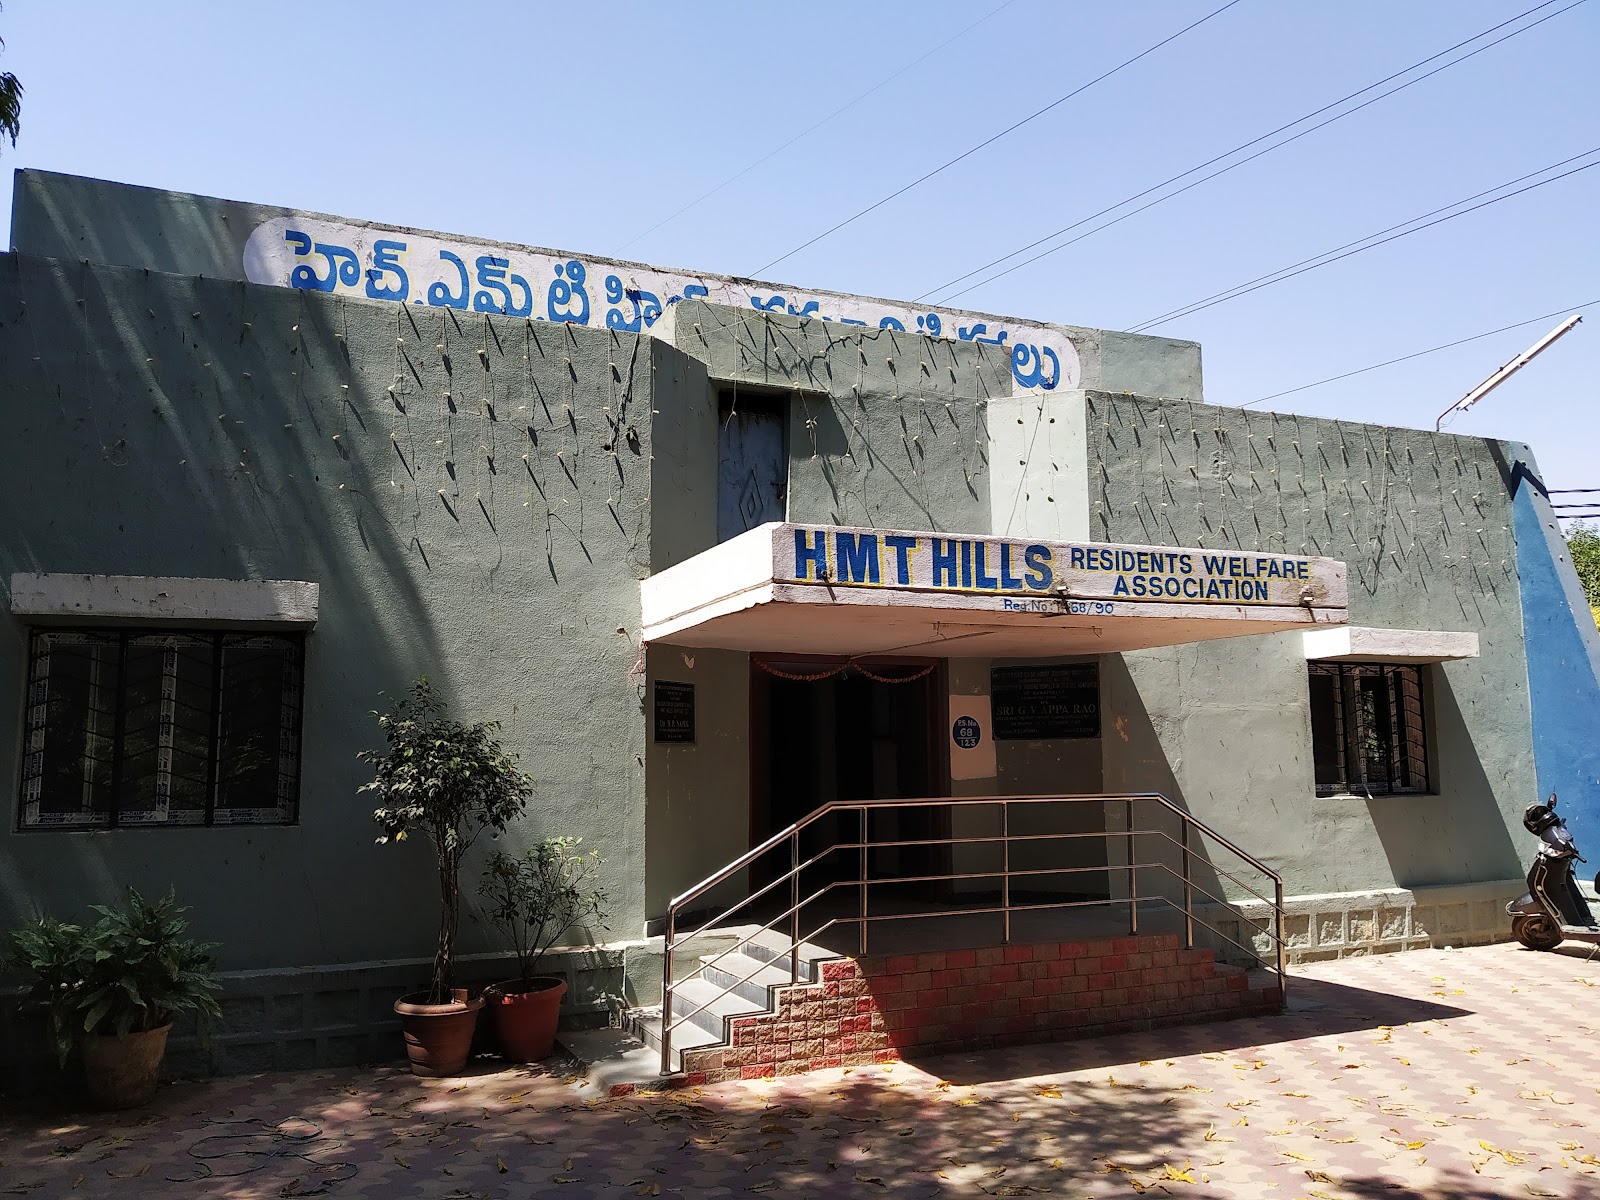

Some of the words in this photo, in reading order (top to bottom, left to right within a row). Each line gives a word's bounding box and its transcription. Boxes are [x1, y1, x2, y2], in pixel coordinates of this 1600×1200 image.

[794, 529, 918, 586] HMT
[931, 537, 1053, 591] HILLS
[1071, 547, 1192, 575] RESIDENTS
[1202, 555, 1309, 580] WELFARE
[1113, 574, 1268, 601] ASSOCIATION
[996, 706, 1014, 716] SRI
[1018, 705, 1026, 715] G
[1042, 704, 1069, 714] APPA
[1073, 703, 1096, 714] RAO
[960, 728, 973, 737] 68
[960, 739, 976, 747] 123
